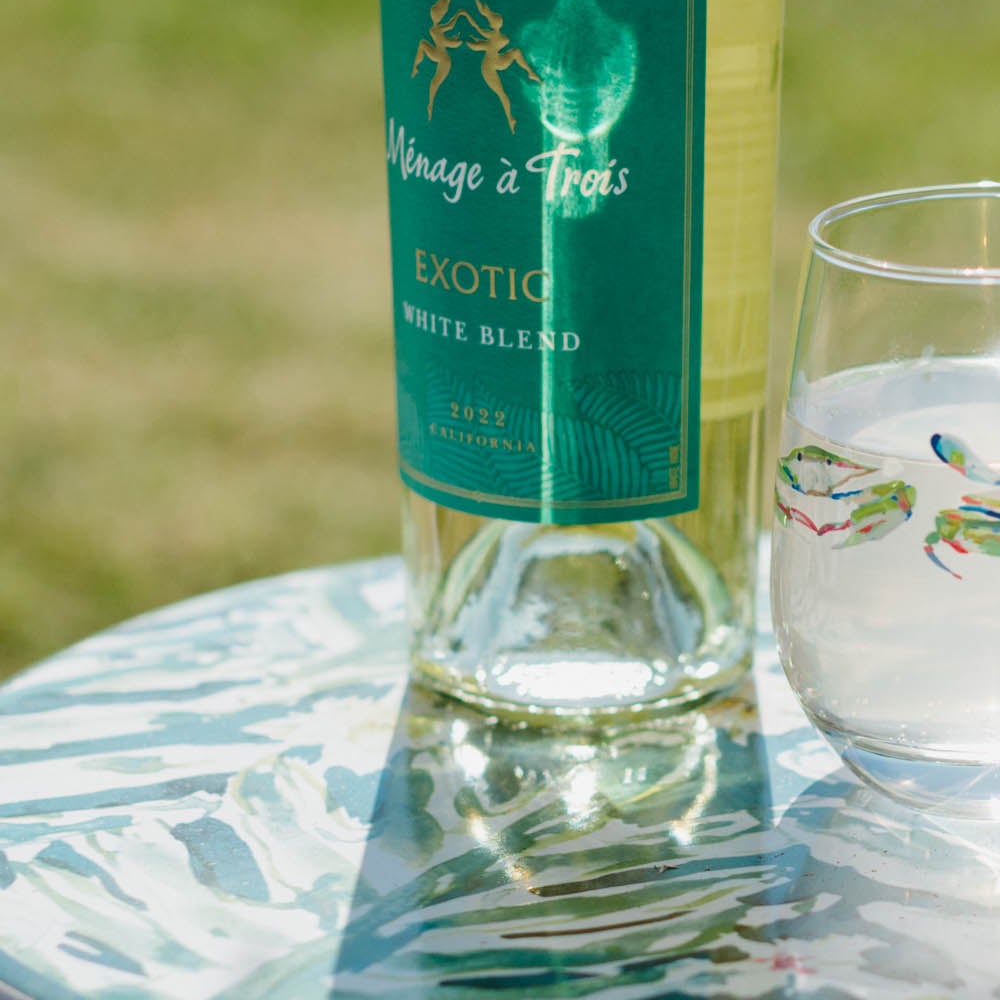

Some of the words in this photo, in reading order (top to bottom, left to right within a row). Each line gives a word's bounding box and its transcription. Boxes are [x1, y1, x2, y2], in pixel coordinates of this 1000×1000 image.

[387, 117, 484, 203] Ménage
[496, 157, 520, 195] à
[525, 142, 630, 201] Trois
[415, 248, 551, 303] EXOTIC
[403, 301, 468, 342] WHITE
[480, 325, 581, 352] BLEND
[430, 422, 536, 453] CALIFORNIA
[450, 401, 505, 427] 2022
